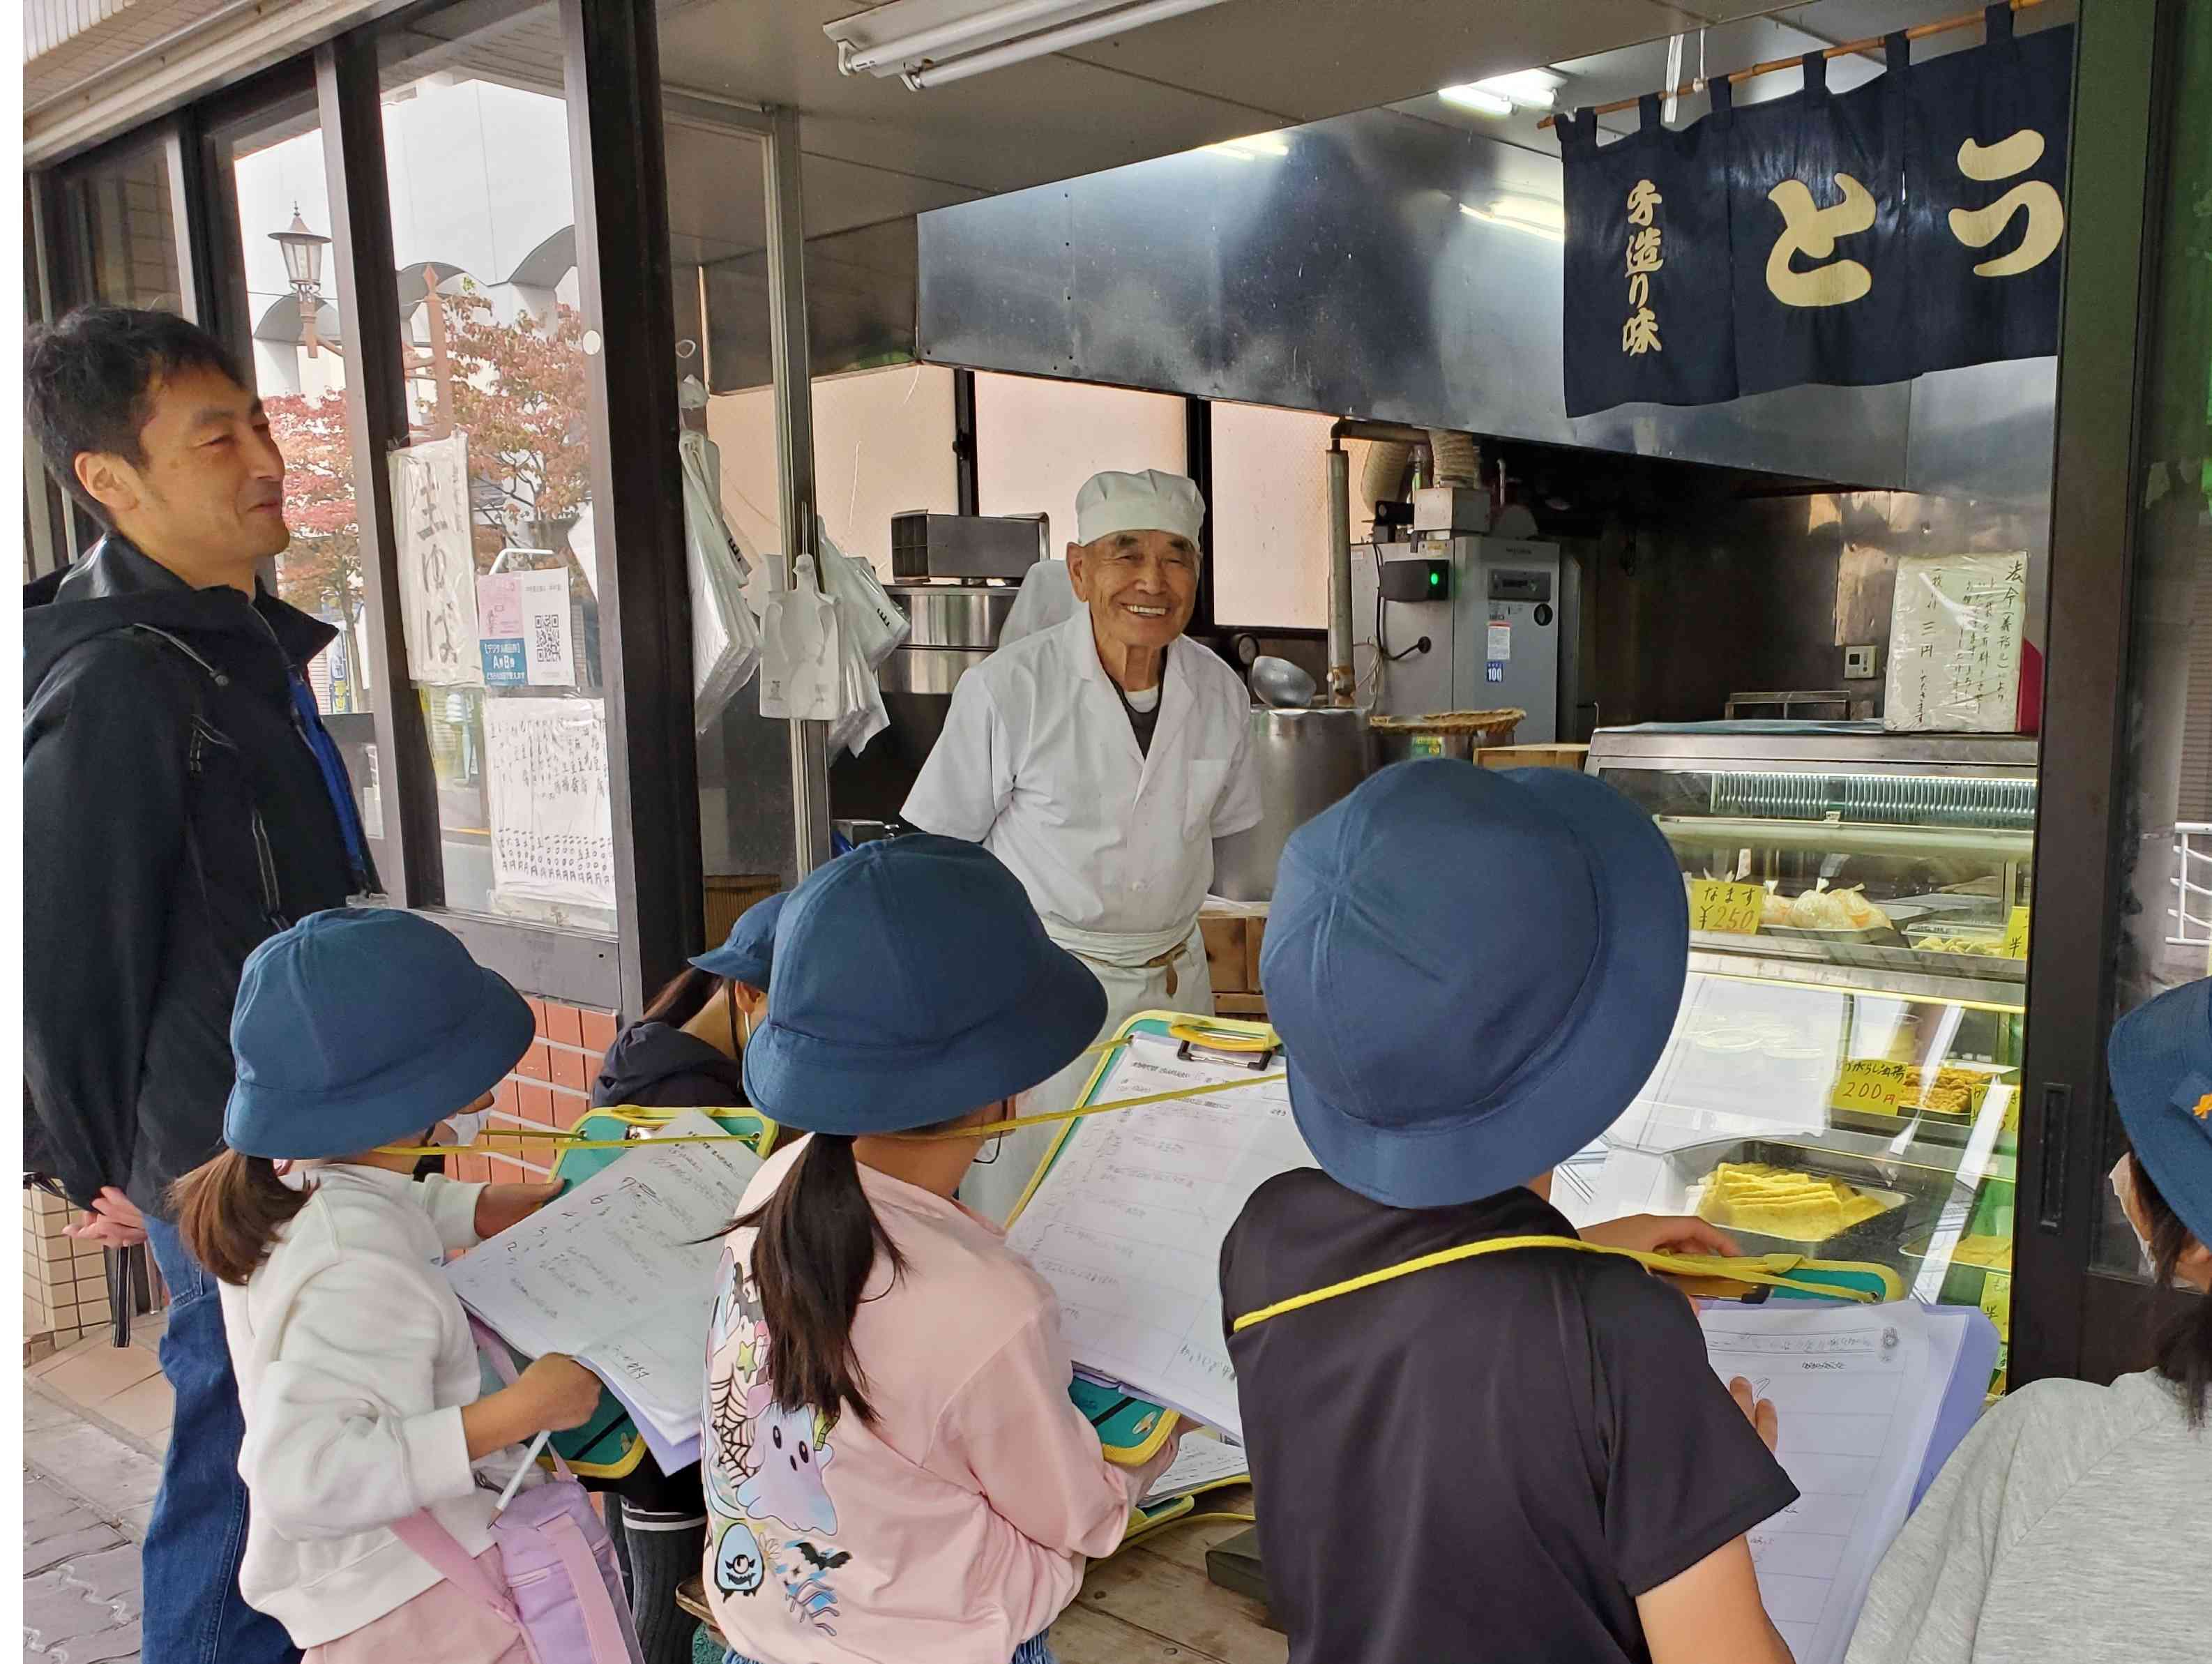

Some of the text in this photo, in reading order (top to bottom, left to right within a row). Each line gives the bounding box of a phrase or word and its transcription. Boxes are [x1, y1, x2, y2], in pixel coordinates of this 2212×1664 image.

[1621, 179, 1664, 356] 手造り味
[417, 460, 458, 665] 生ゆば
[1488, 667, 1502, 681] 100
[1704, 886, 1756, 907] なます
[1698, 905, 1755, 930] ¥250
[1842, 1081, 1897, 1105] 200円
